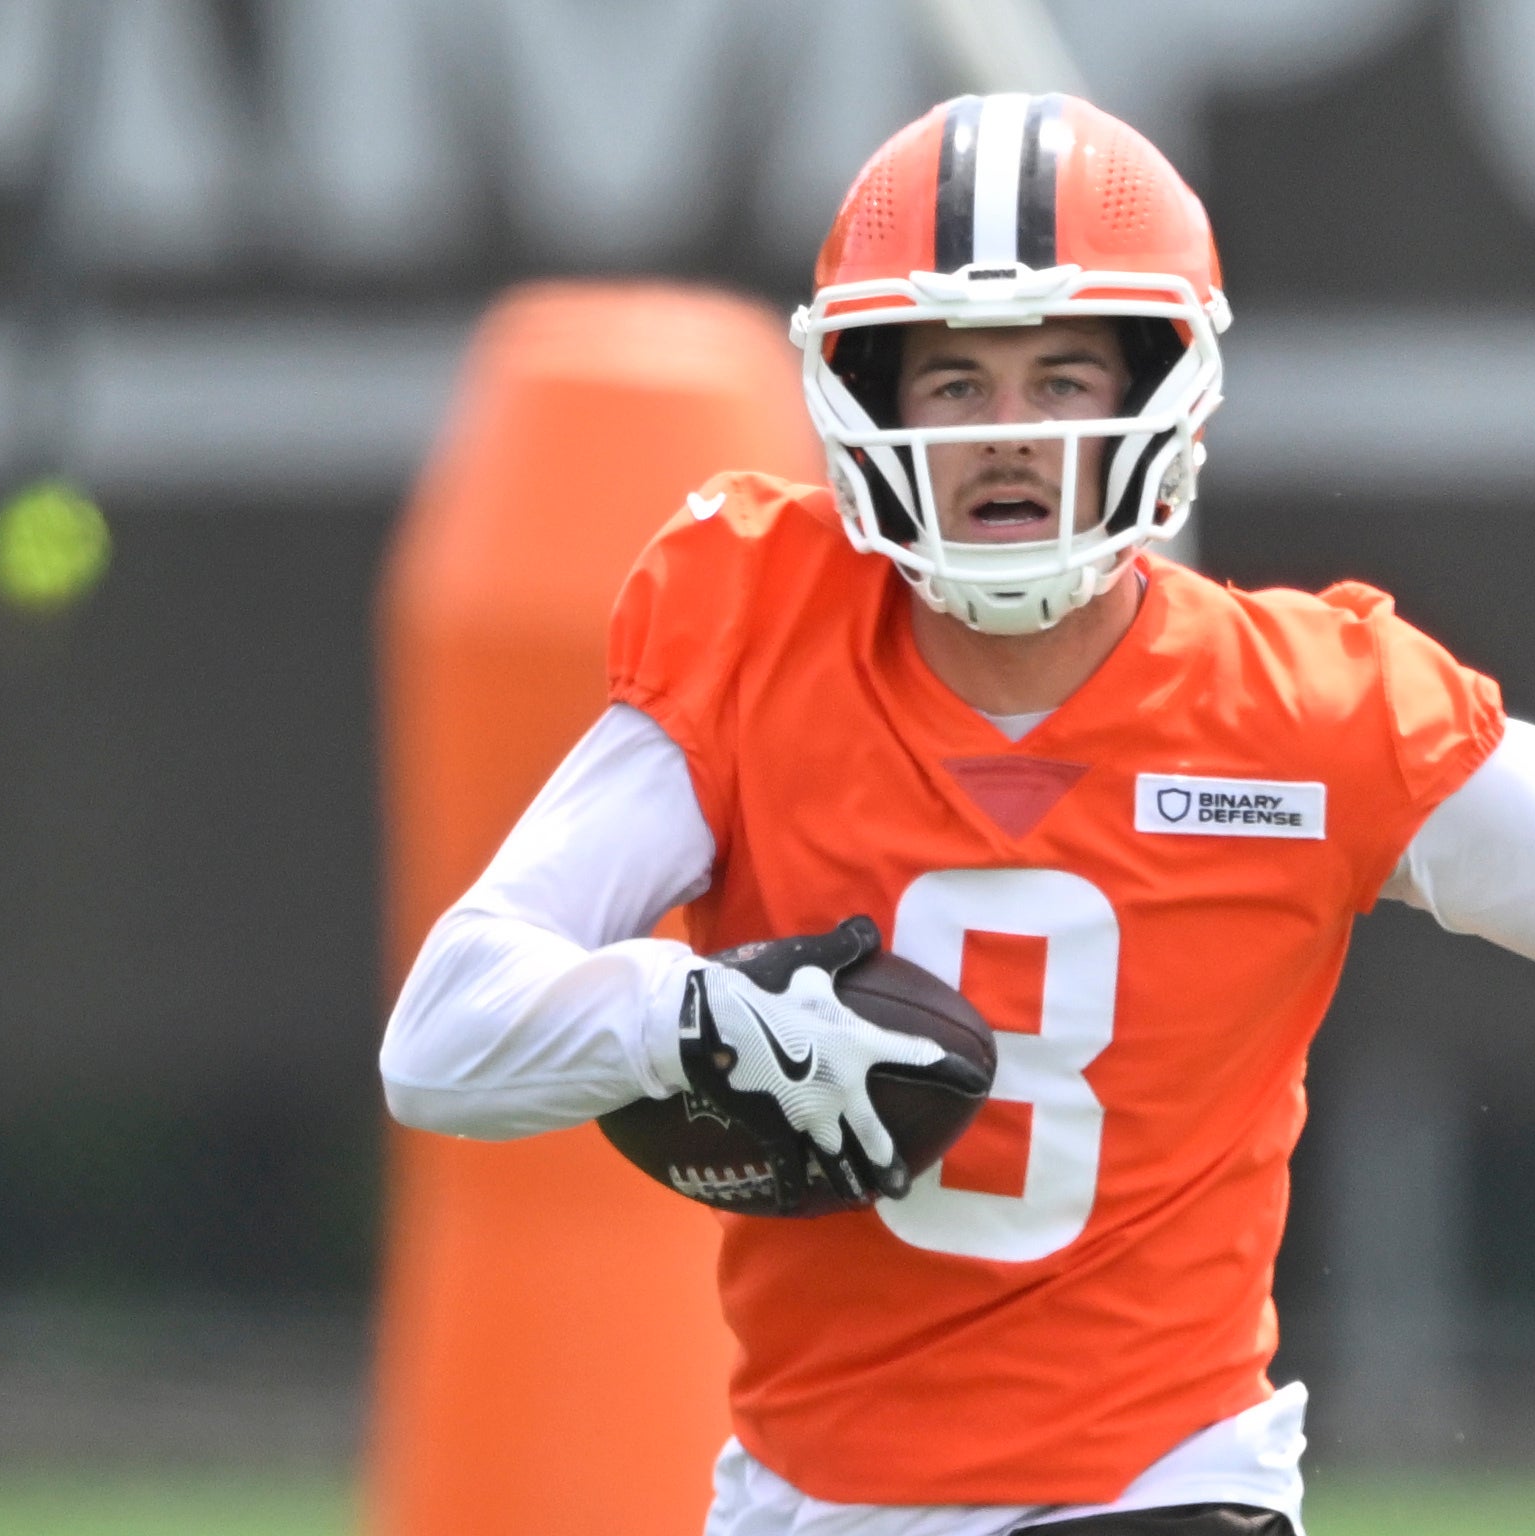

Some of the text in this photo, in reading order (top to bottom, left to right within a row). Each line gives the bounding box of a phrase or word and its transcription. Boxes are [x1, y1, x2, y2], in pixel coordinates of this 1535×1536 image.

[1199, 793, 1283, 809] BINARY
[1198, 809, 1302, 826] DEFENSE
[875, 869, 1120, 1262] 8
